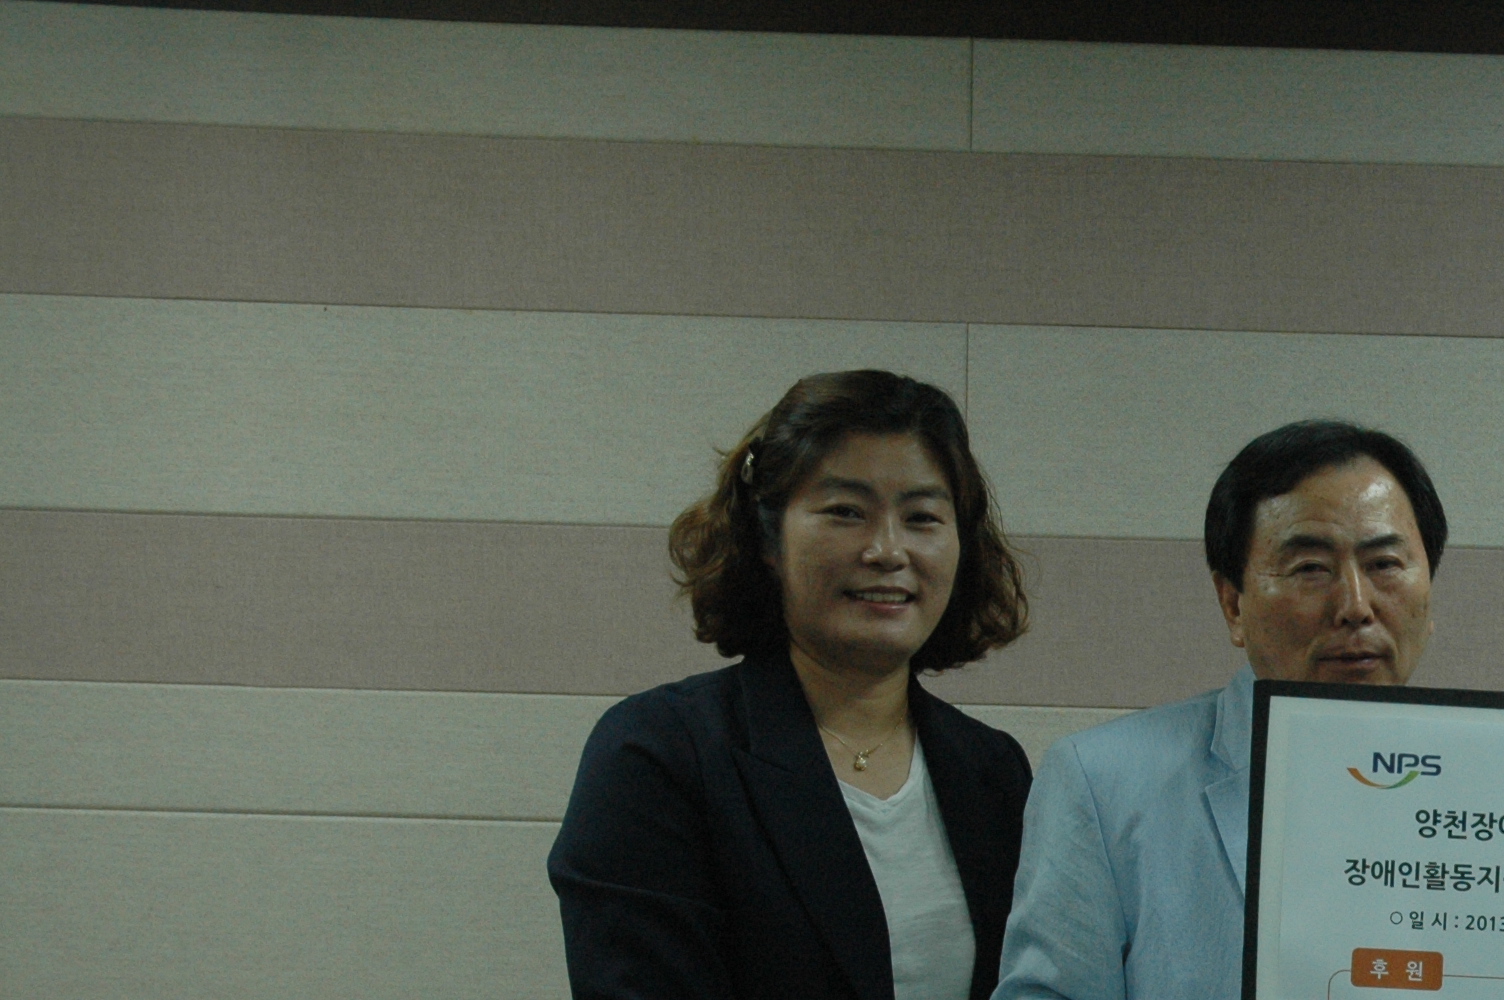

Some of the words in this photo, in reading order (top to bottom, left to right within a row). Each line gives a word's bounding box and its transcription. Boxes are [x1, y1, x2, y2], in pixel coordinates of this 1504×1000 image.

[1372, 752, 1442, 777] NPS
[1408, 911, 1425, 930] 일
[1432, 912, 1448, 931] 시
